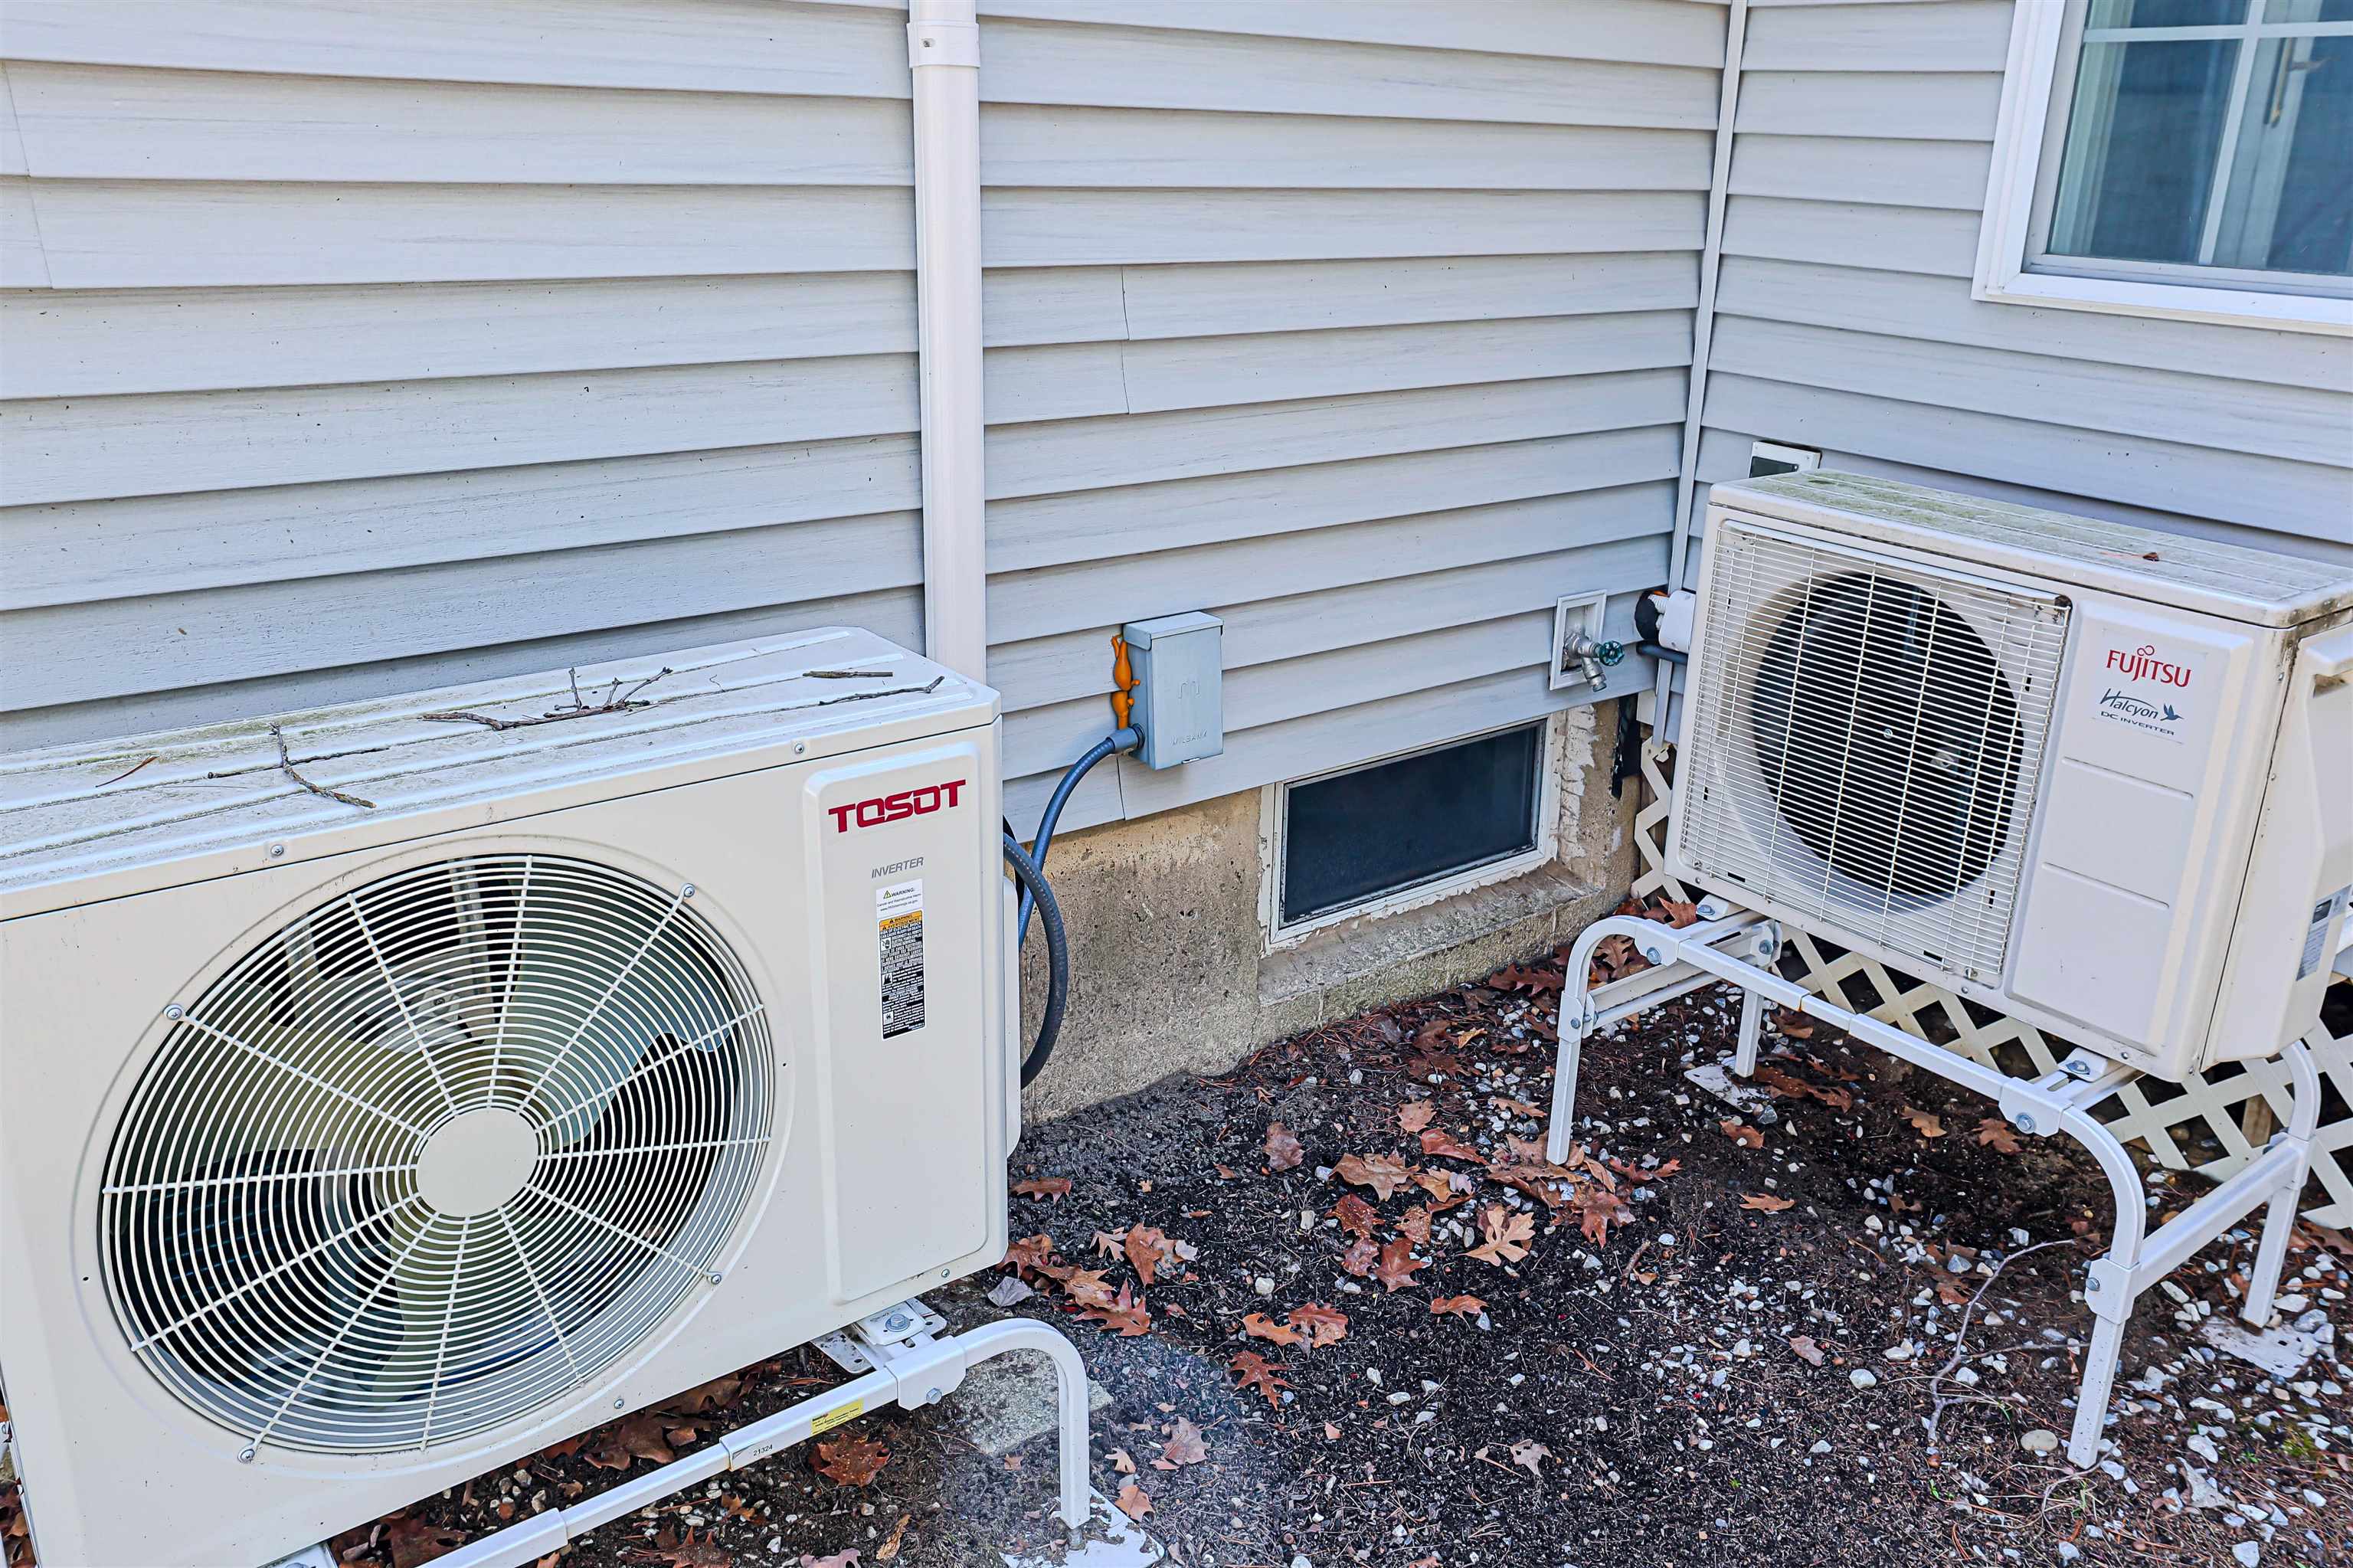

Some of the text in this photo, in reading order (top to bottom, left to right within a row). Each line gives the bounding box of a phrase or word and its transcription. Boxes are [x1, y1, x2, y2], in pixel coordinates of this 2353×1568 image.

[2106, 646, 2191, 687] FUJITSU
[2099, 688, 2158, 719] Halcyon
[2101, 711, 2175, 736] DC INVERTER
[828, 779, 966, 833] TOSOT
[871, 856, 924, 879] INVERTER
[753, 1444, 773, 1456] 21324
